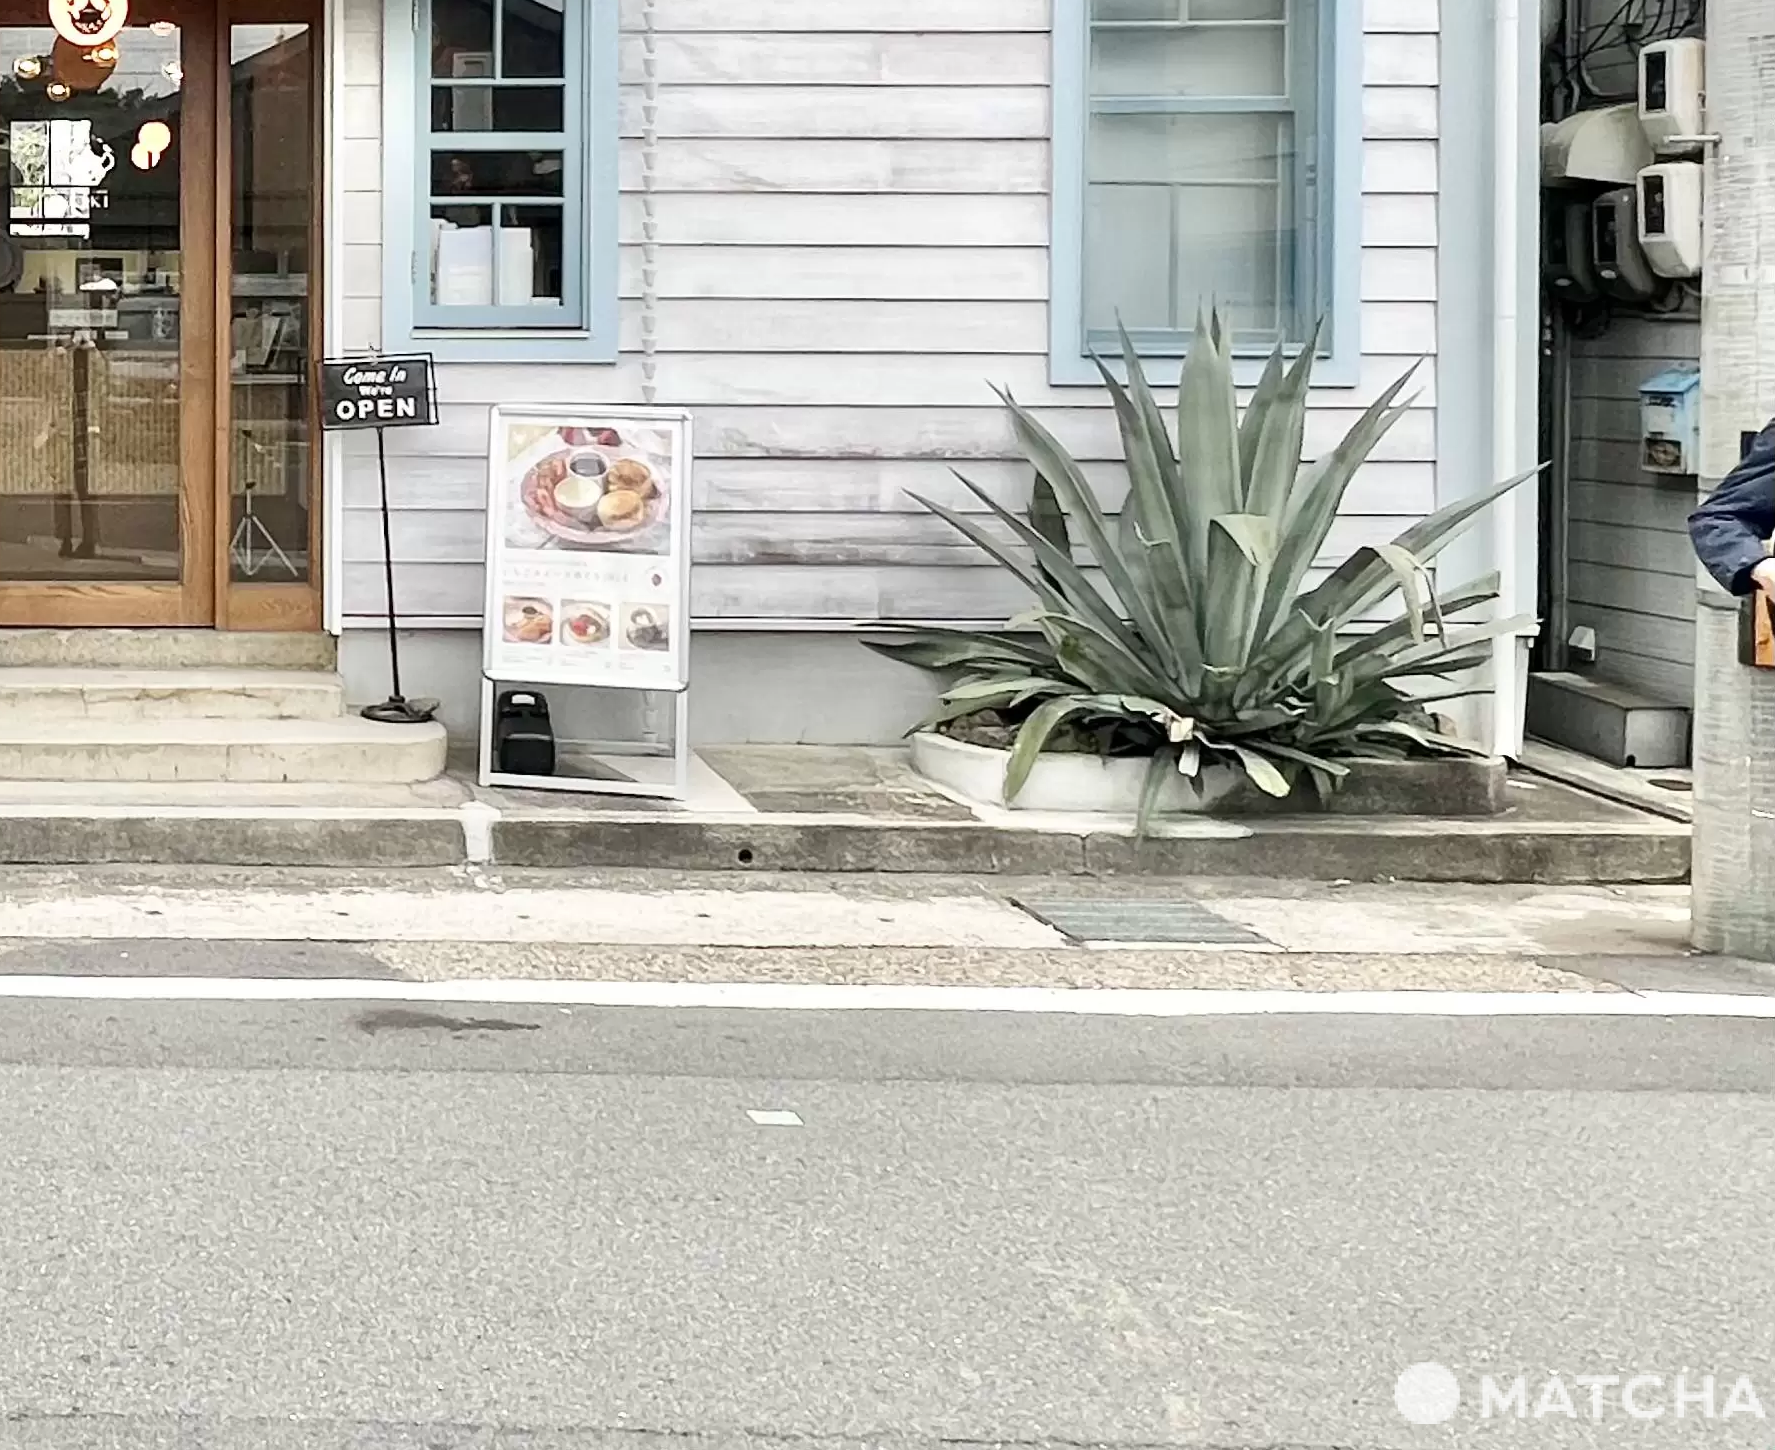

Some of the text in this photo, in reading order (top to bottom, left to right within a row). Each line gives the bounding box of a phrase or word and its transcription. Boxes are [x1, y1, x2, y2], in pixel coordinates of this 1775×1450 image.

[343, 365, 407, 385] Come In
[336, 397, 415, 420] OPEN
